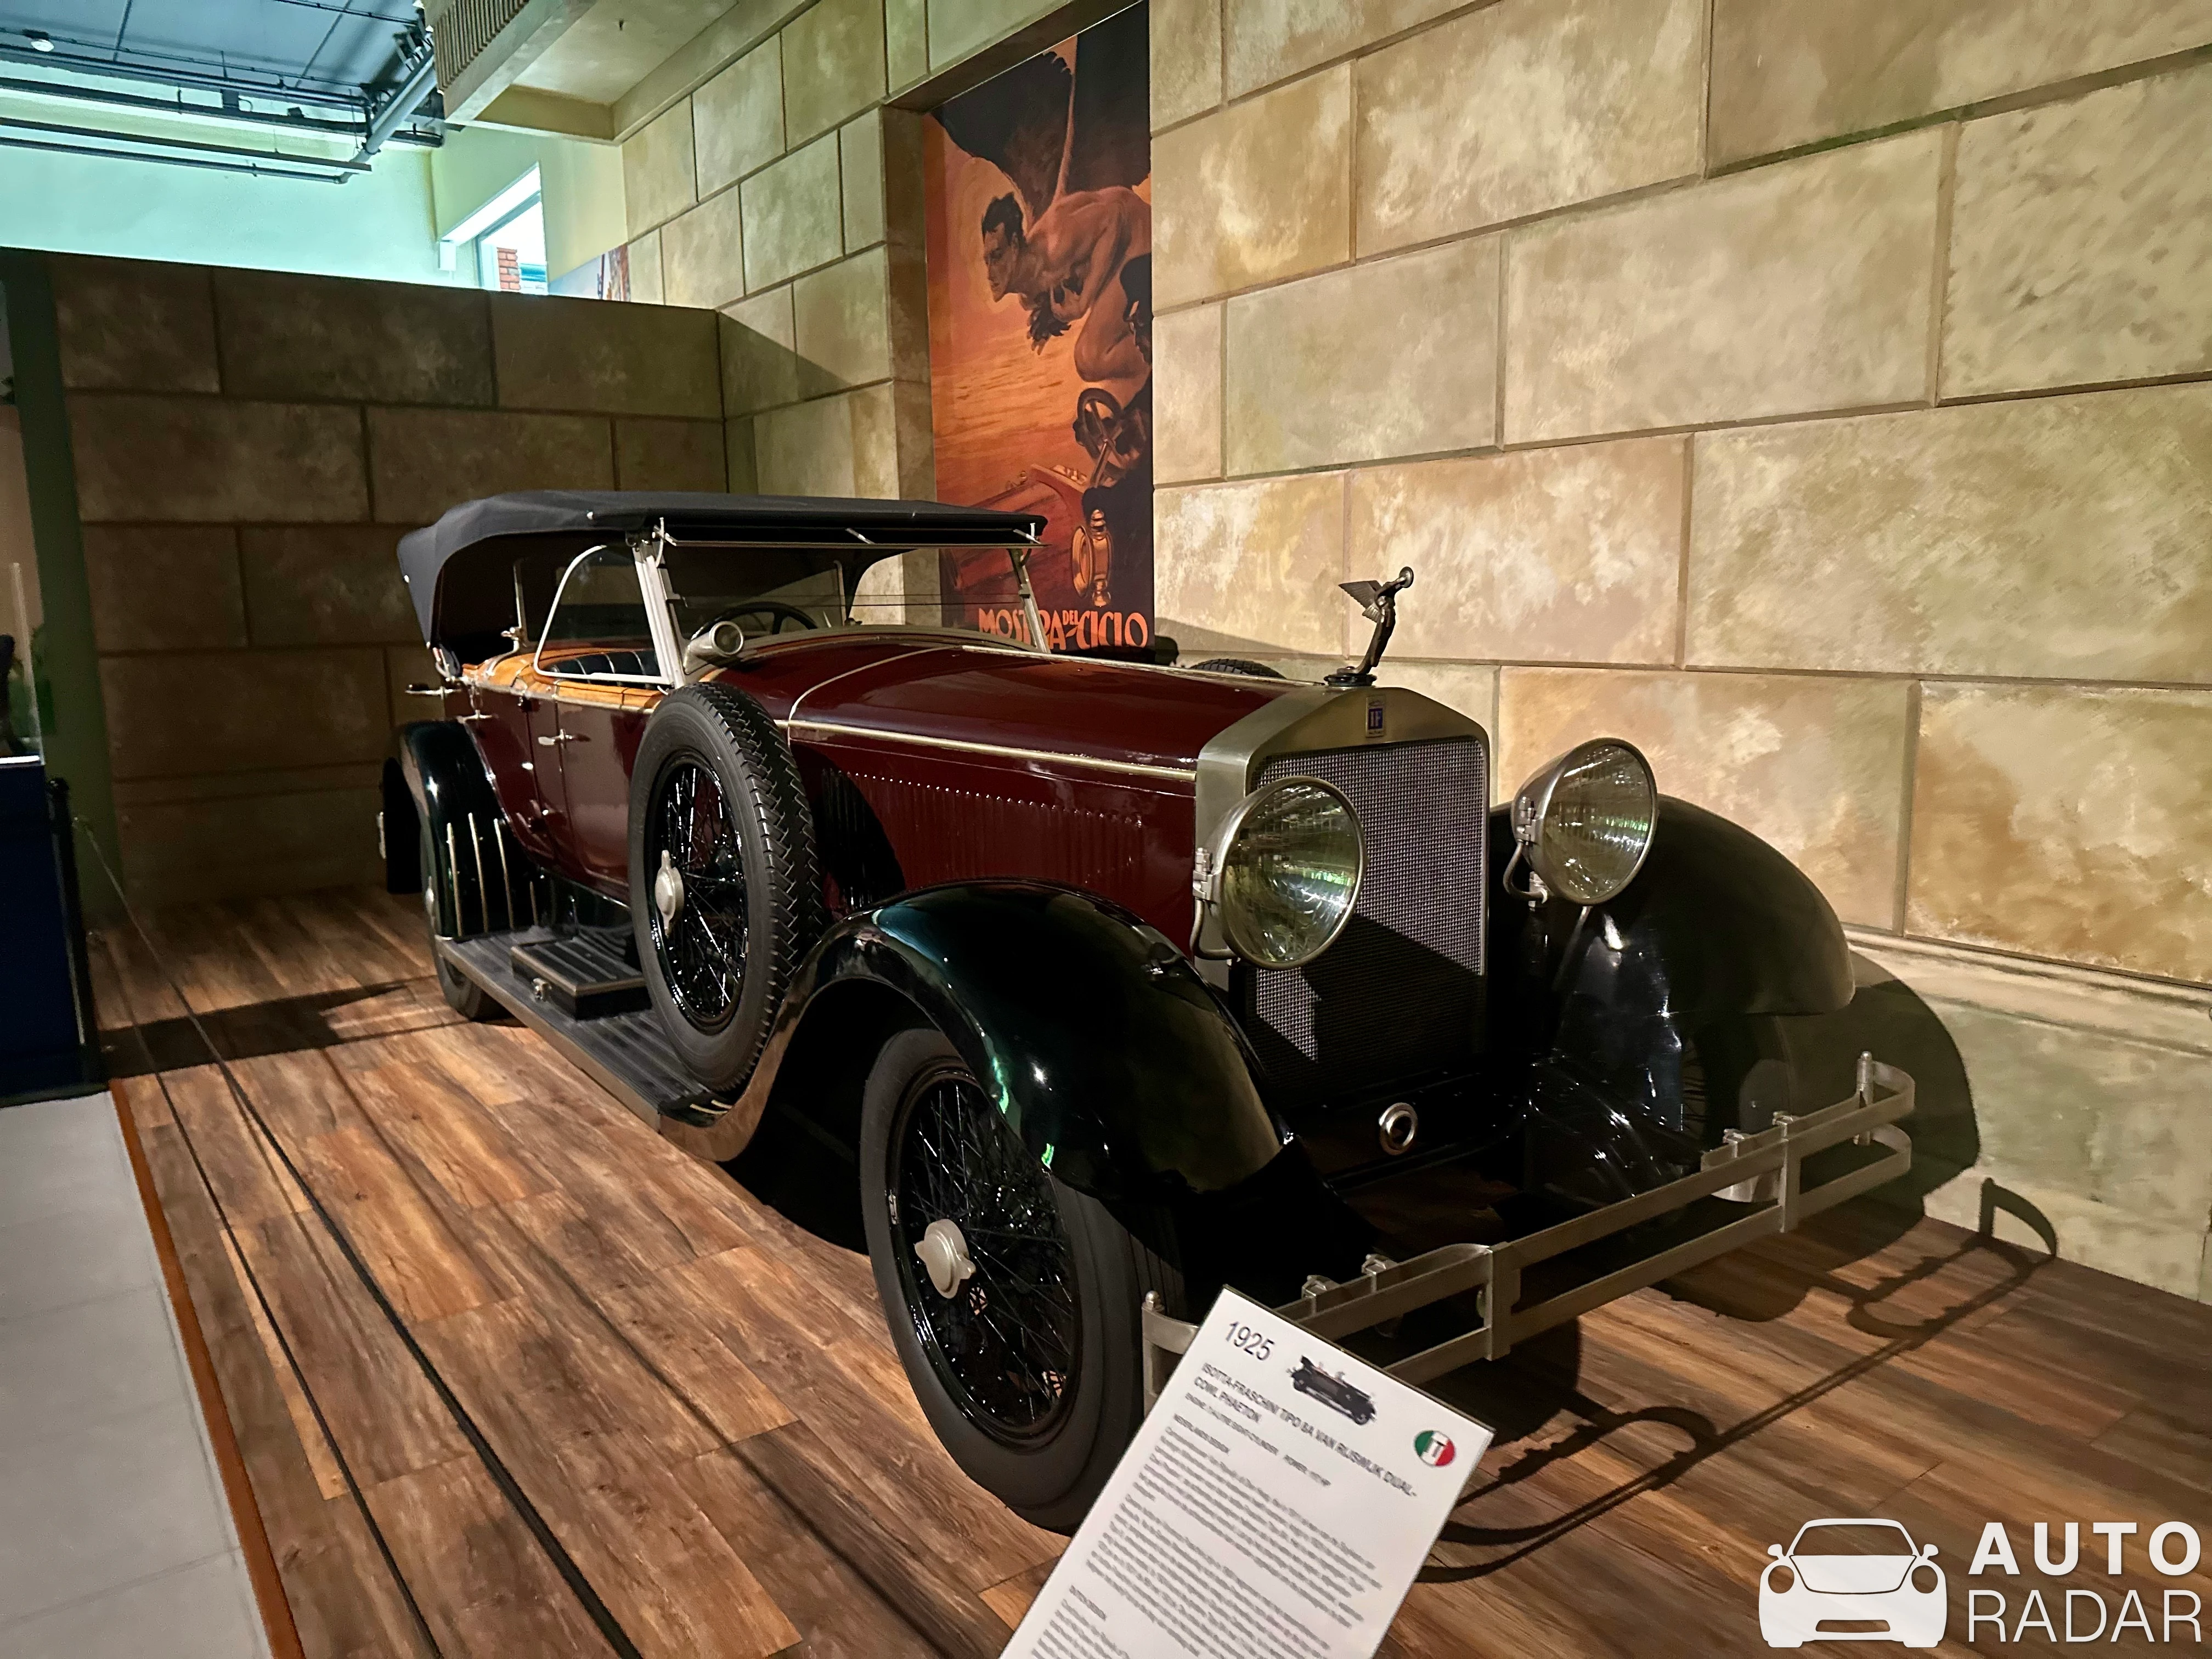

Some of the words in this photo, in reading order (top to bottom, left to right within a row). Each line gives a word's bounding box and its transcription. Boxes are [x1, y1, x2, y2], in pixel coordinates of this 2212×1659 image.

[1062, 610, 1079, 625] DEL
[1076, 610, 1148, 650] CICLO
[1225, 1321, 1275, 1361] 1925
[1279, 1408, 1301, 1427] TIPO
